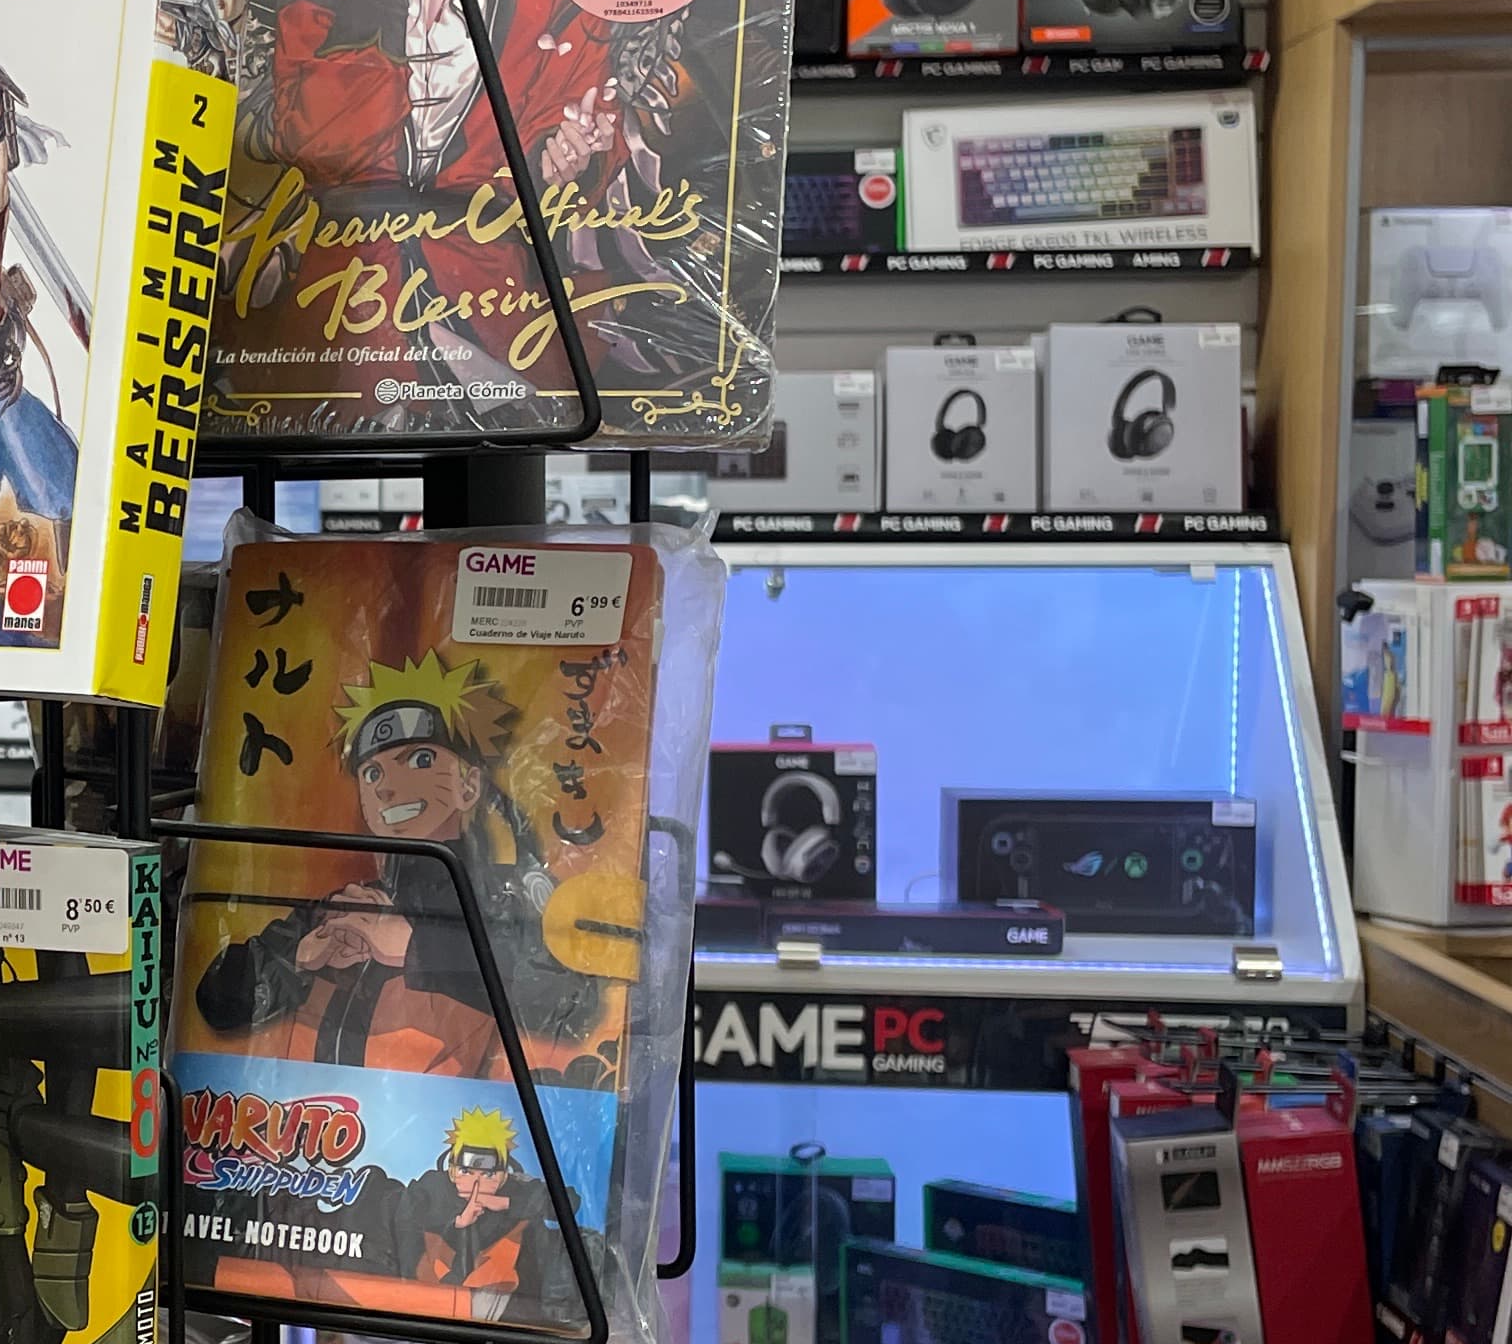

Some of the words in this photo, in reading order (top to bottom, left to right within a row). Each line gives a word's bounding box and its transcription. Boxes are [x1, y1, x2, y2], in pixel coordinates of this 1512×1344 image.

[943, 61, 1002, 76] GAMING
[191, 93, 208, 129] 2
[1123, 226, 1209, 245] WIRELESS
[908, 256, 967, 271] GAMING
[1055, 255, 1114, 269] GAMING
[118, 140, 180, 534] MAXIMUM
[145, 154, 228, 538] BERSERK
[216, 349, 240, 364] La
[242, 346, 316, 365] bendición
[320, 346, 342, 364] del
[346, 346, 401, 364] Oficial
[404, 346, 428, 363] del
[431, 346, 473, 363] Cielo
[399, 382, 464, 403] Planeta
[468, 378, 526, 400] Cómic
[902, 516, 962, 531] GAMING
[1053, 516, 1114, 531] GAMING
[1206, 516, 1268, 531] GAMING
[465, 552, 537, 575] GAME
[4, 615, 43, 630] manga
[470, 617, 499, 627] MERC
[469, 628, 514, 638] Cuaderno
[555, 630, 586, 640] Naruto
[61, 924, 81, 934] PVP
[1006, 928, 1049, 945] GAME
[131, 862, 161, 1030] KAIJU
[873, 1008, 945, 1053] PC
[872, 1055, 945, 1073] GAMING
[131, 1068, 161, 1158] 8
[184, 1086, 365, 1163] NARUTO
[202, 1159, 371, 1206] SHIPPUDEN
[244, 1220, 364, 1259] NOTEBOOK
